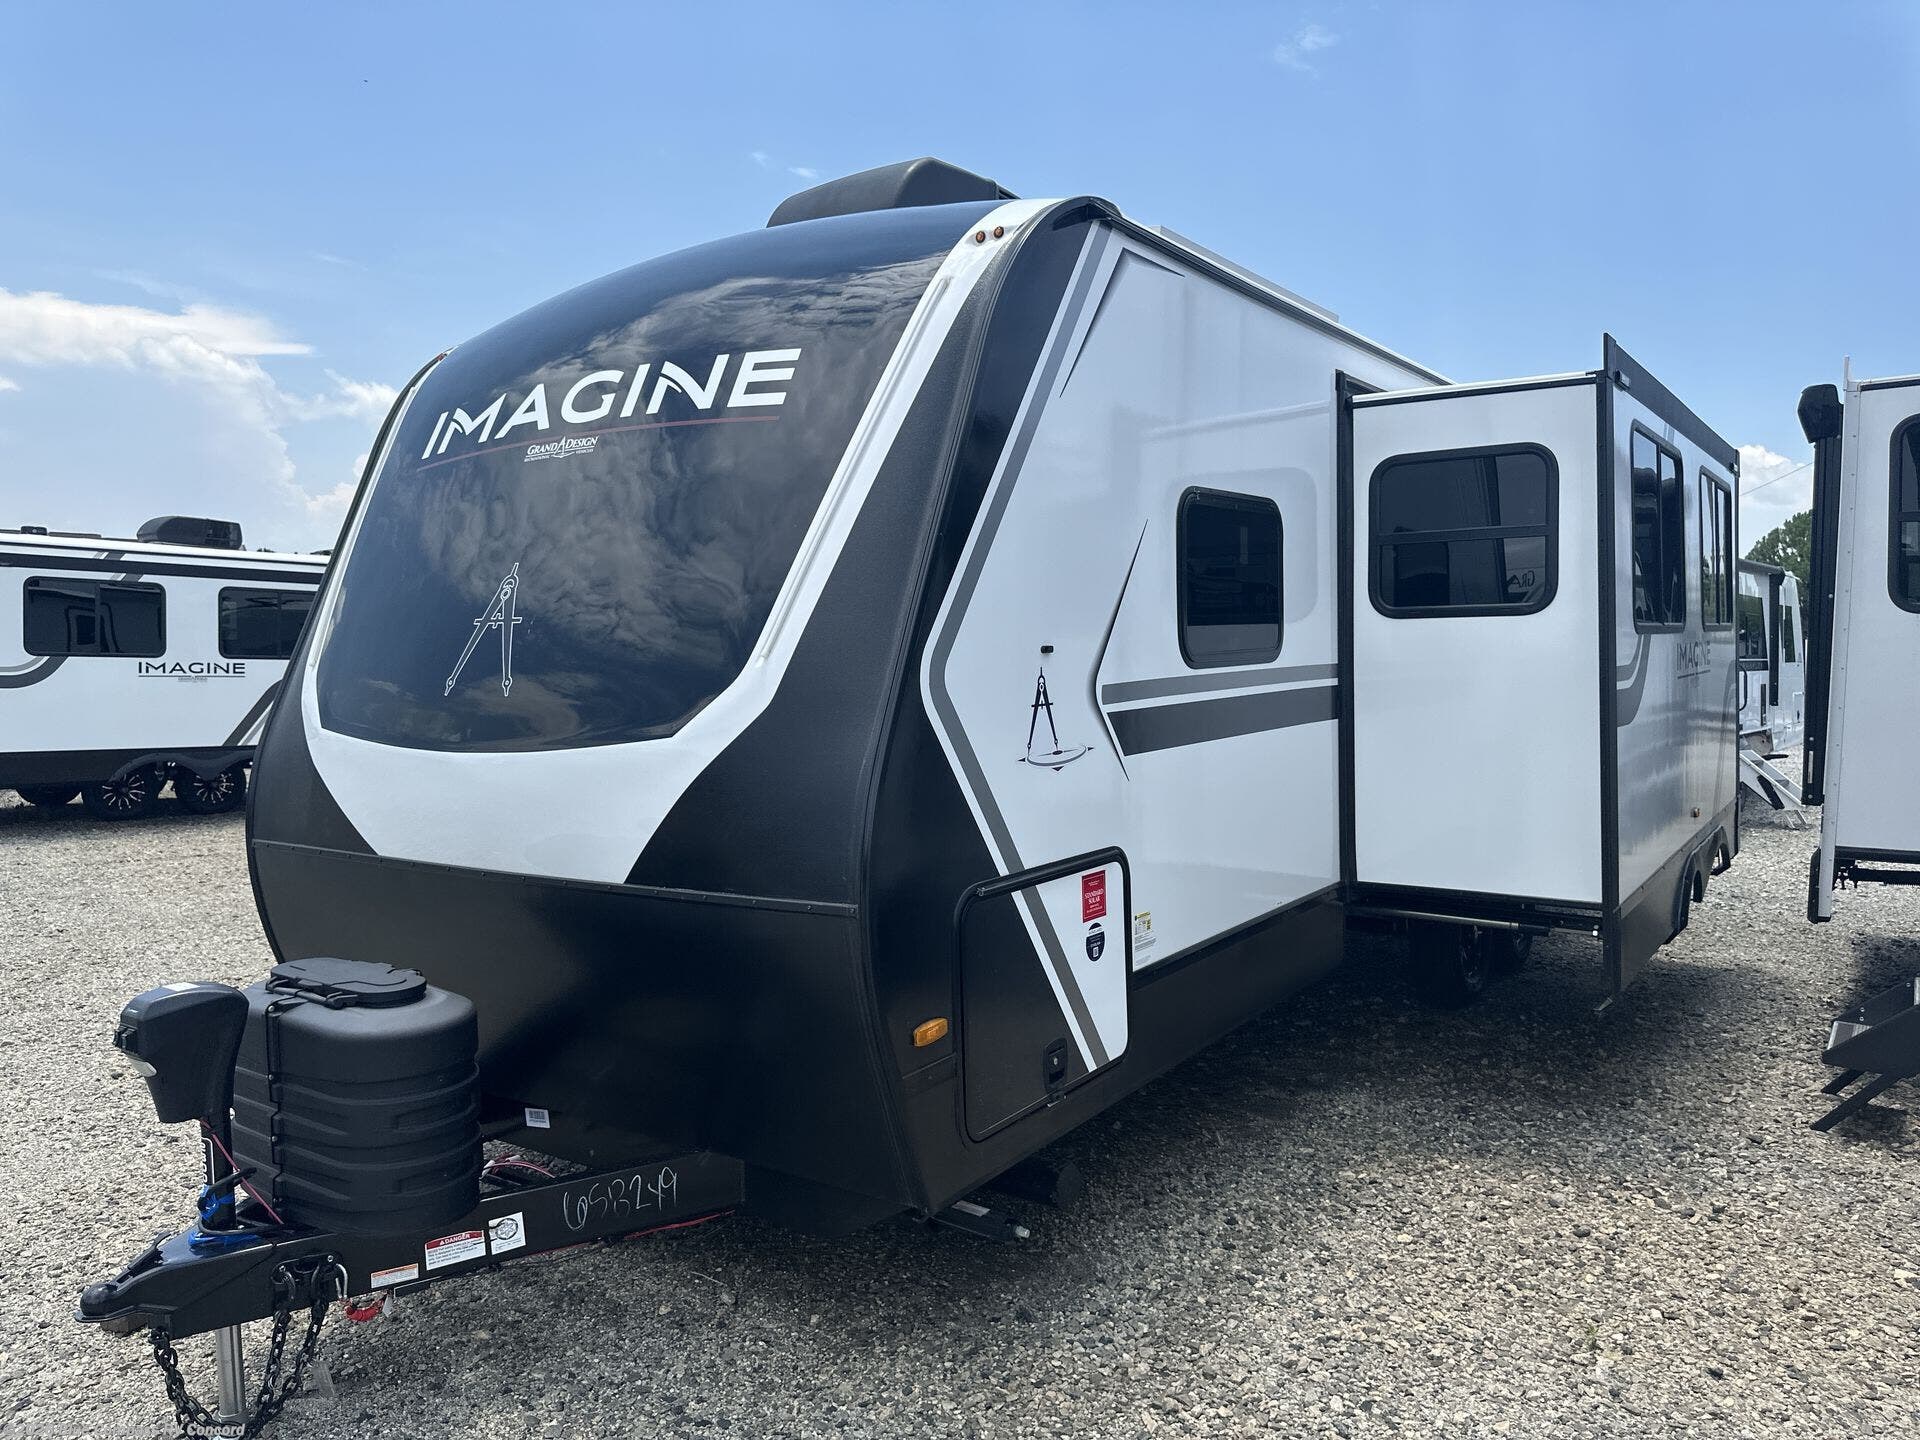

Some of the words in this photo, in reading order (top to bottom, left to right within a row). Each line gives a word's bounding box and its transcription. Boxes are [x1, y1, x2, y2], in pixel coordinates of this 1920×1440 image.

[421, 348, 802, 460] IMAGINE
[527, 442, 558, 455] GRAND
[565, 435, 599, 449] DESIGN
[1676, 640, 1711, 671] IMAGINE
[138, 661, 246, 674] IMAGINE
[445, 1232, 471, 1245] DANGER
